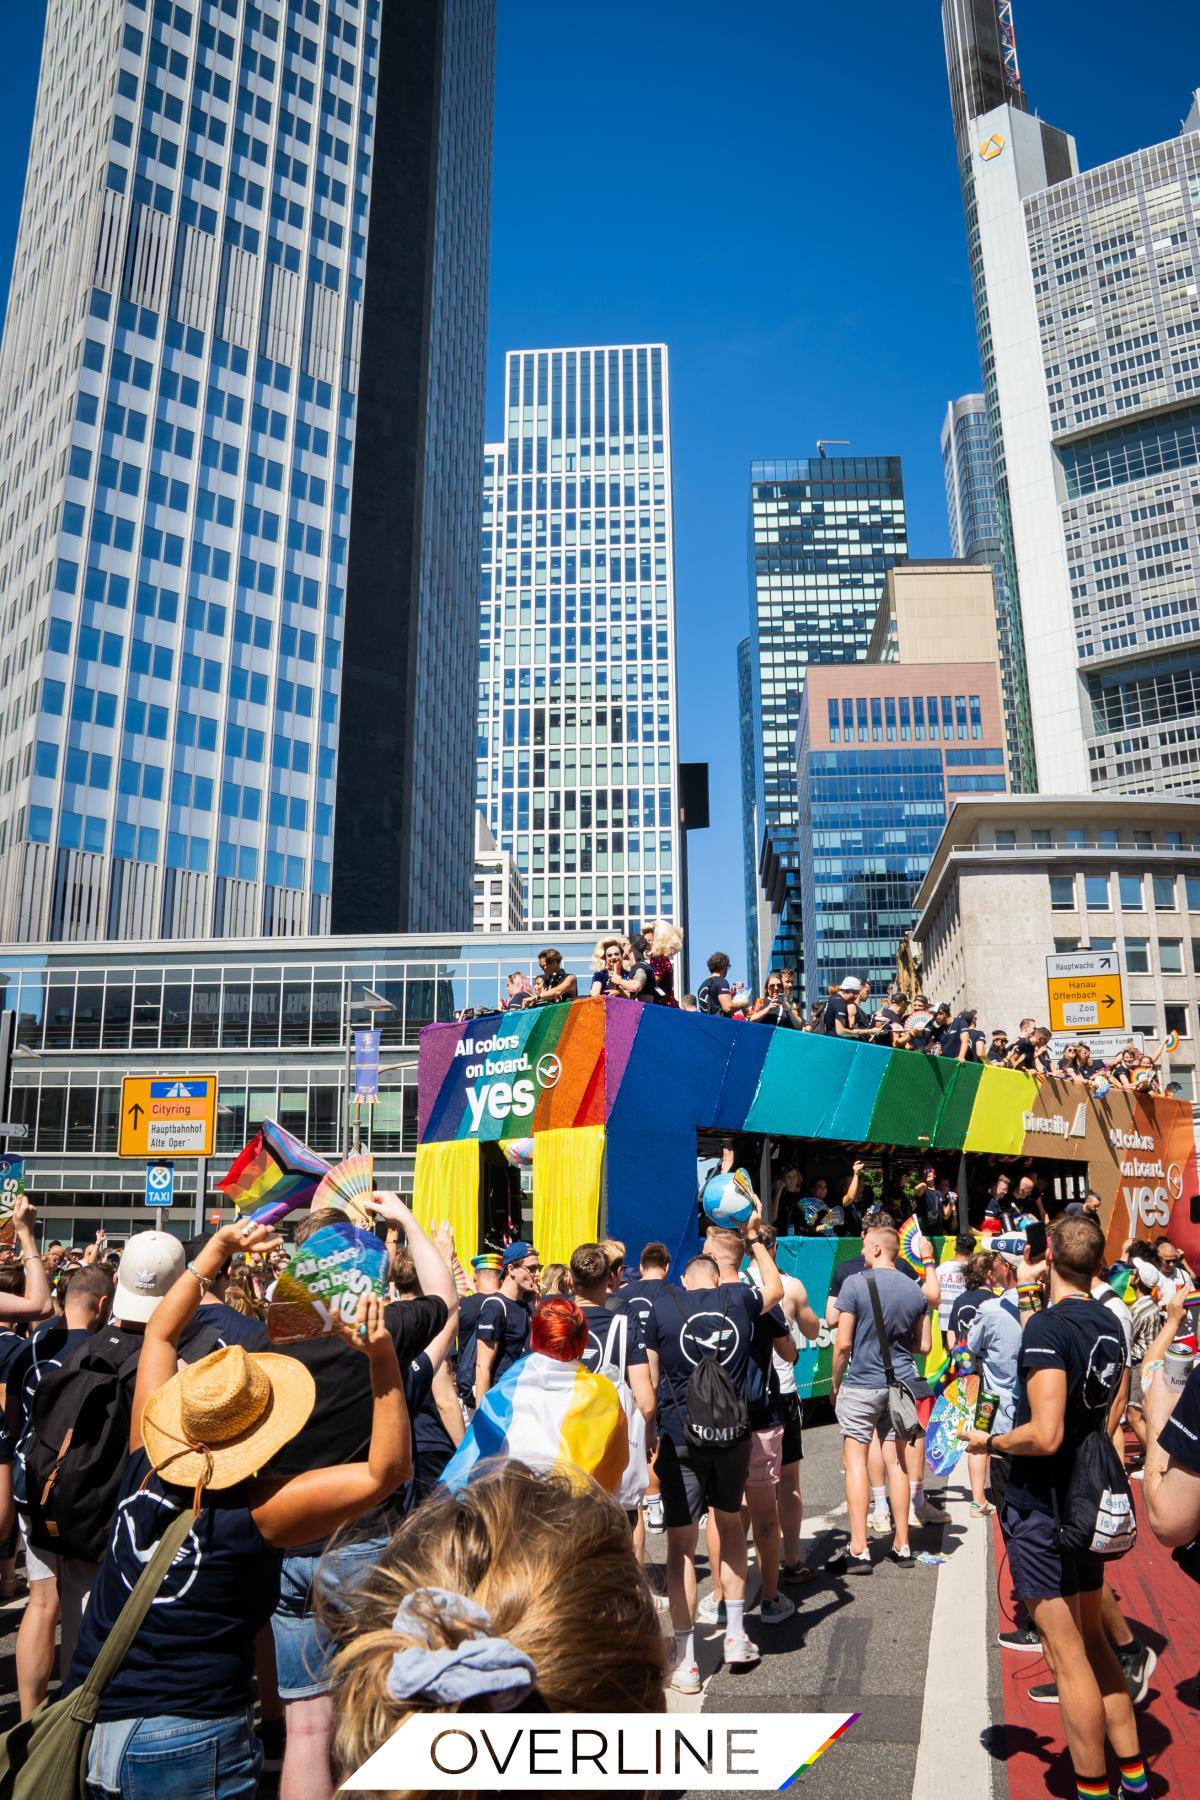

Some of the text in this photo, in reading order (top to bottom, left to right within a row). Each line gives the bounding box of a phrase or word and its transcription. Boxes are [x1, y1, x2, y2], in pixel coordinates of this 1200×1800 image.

[1055, 962, 1094, 971] Hauptwache
[1068, 981, 1096, 989] Hanau
[1053, 991, 1097, 1000] Offenbach
[1079, 1004, 1095, 1012] Zoo
[455, 1035, 520, 1057] All colors
[465, 1053, 532, 1079] on board.
[152, 1104, 191, 1116] Cityring
[465, 1080, 536, 1133] yes
[151, 1123, 203, 1137] Hauptbahnhof
[151, 1138, 186, 1149] Alte Oper
[1110, 1129, 1155, 1151] All colors
[1120, 1158, 1165, 1178] on board.
[148, 1191, 170, 1202] TAXI
[1122, 1186, 1170, 1239] yes
